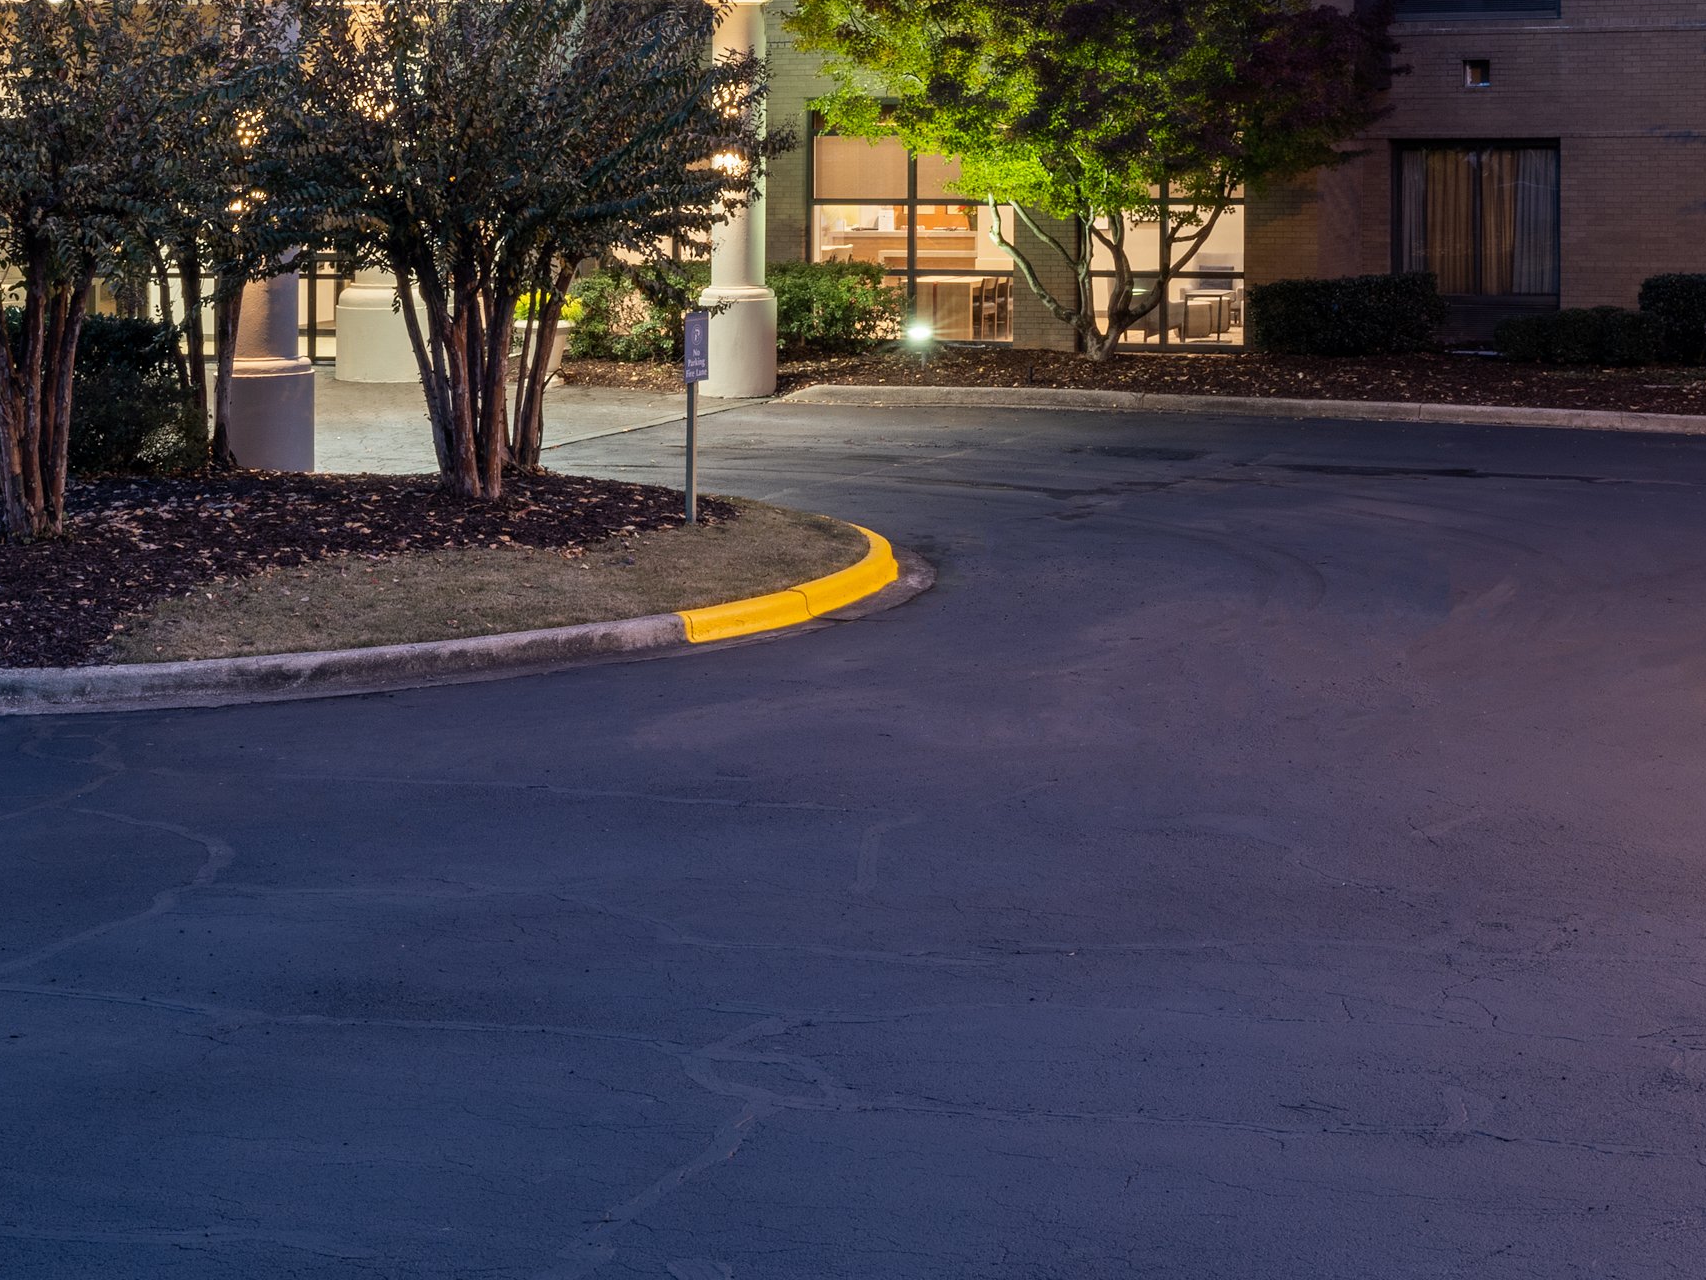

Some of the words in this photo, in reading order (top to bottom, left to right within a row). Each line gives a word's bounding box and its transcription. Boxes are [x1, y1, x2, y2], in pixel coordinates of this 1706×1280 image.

[692, 348, 701, 357] No
[687, 357, 706, 368] Parking
[685, 369, 695, 378] Fire
[695, 368, 707, 377] Lane
